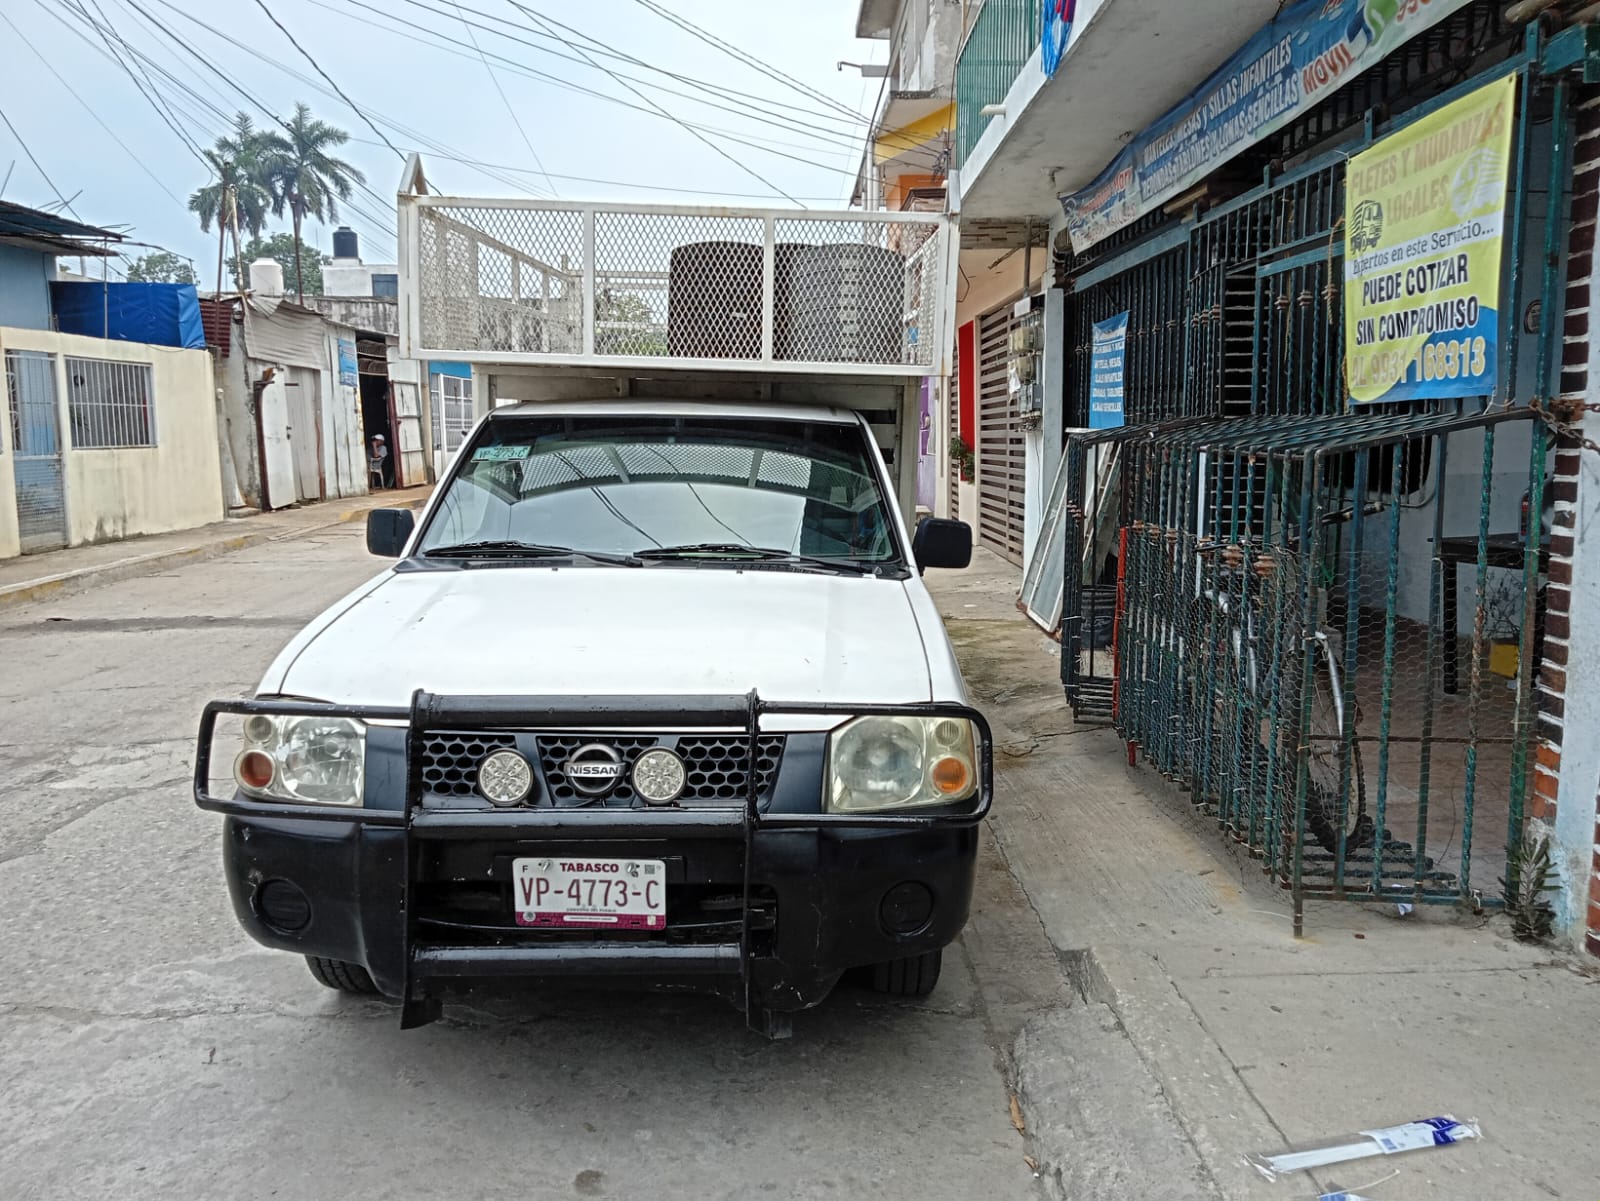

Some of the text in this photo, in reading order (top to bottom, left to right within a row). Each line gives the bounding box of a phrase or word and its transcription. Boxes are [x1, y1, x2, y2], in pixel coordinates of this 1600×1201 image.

[1209, 77, 1238, 119] SILLAS
[1240, 33, 1292, 98] INFANTILES
[1303, 42, 1356, 95] MOVIL
[1247, 73, 1299, 132] SENCILLAS
[1351, 154, 1397, 198] FLETES
[1402, 147, 1410, 178] Y
[1386, 174, 1449, 226] LOCALES
[1353, 251, 1389, 276] Expertos
[1391, 248, 1403, 261] en
[1406, 240, 1428, 256] este
[1363, 253, 1468, 306] PUEDE COTIZAR
[1356, 296, 1479, 346] SIN COMPROMISO
[1414, 335, 1486, 382] 168313
[569, 765, 619, 775] NISSAN
[559, 862, 619, 873] TABASCO
[520, 877, 659, 909] VP-4773-C
